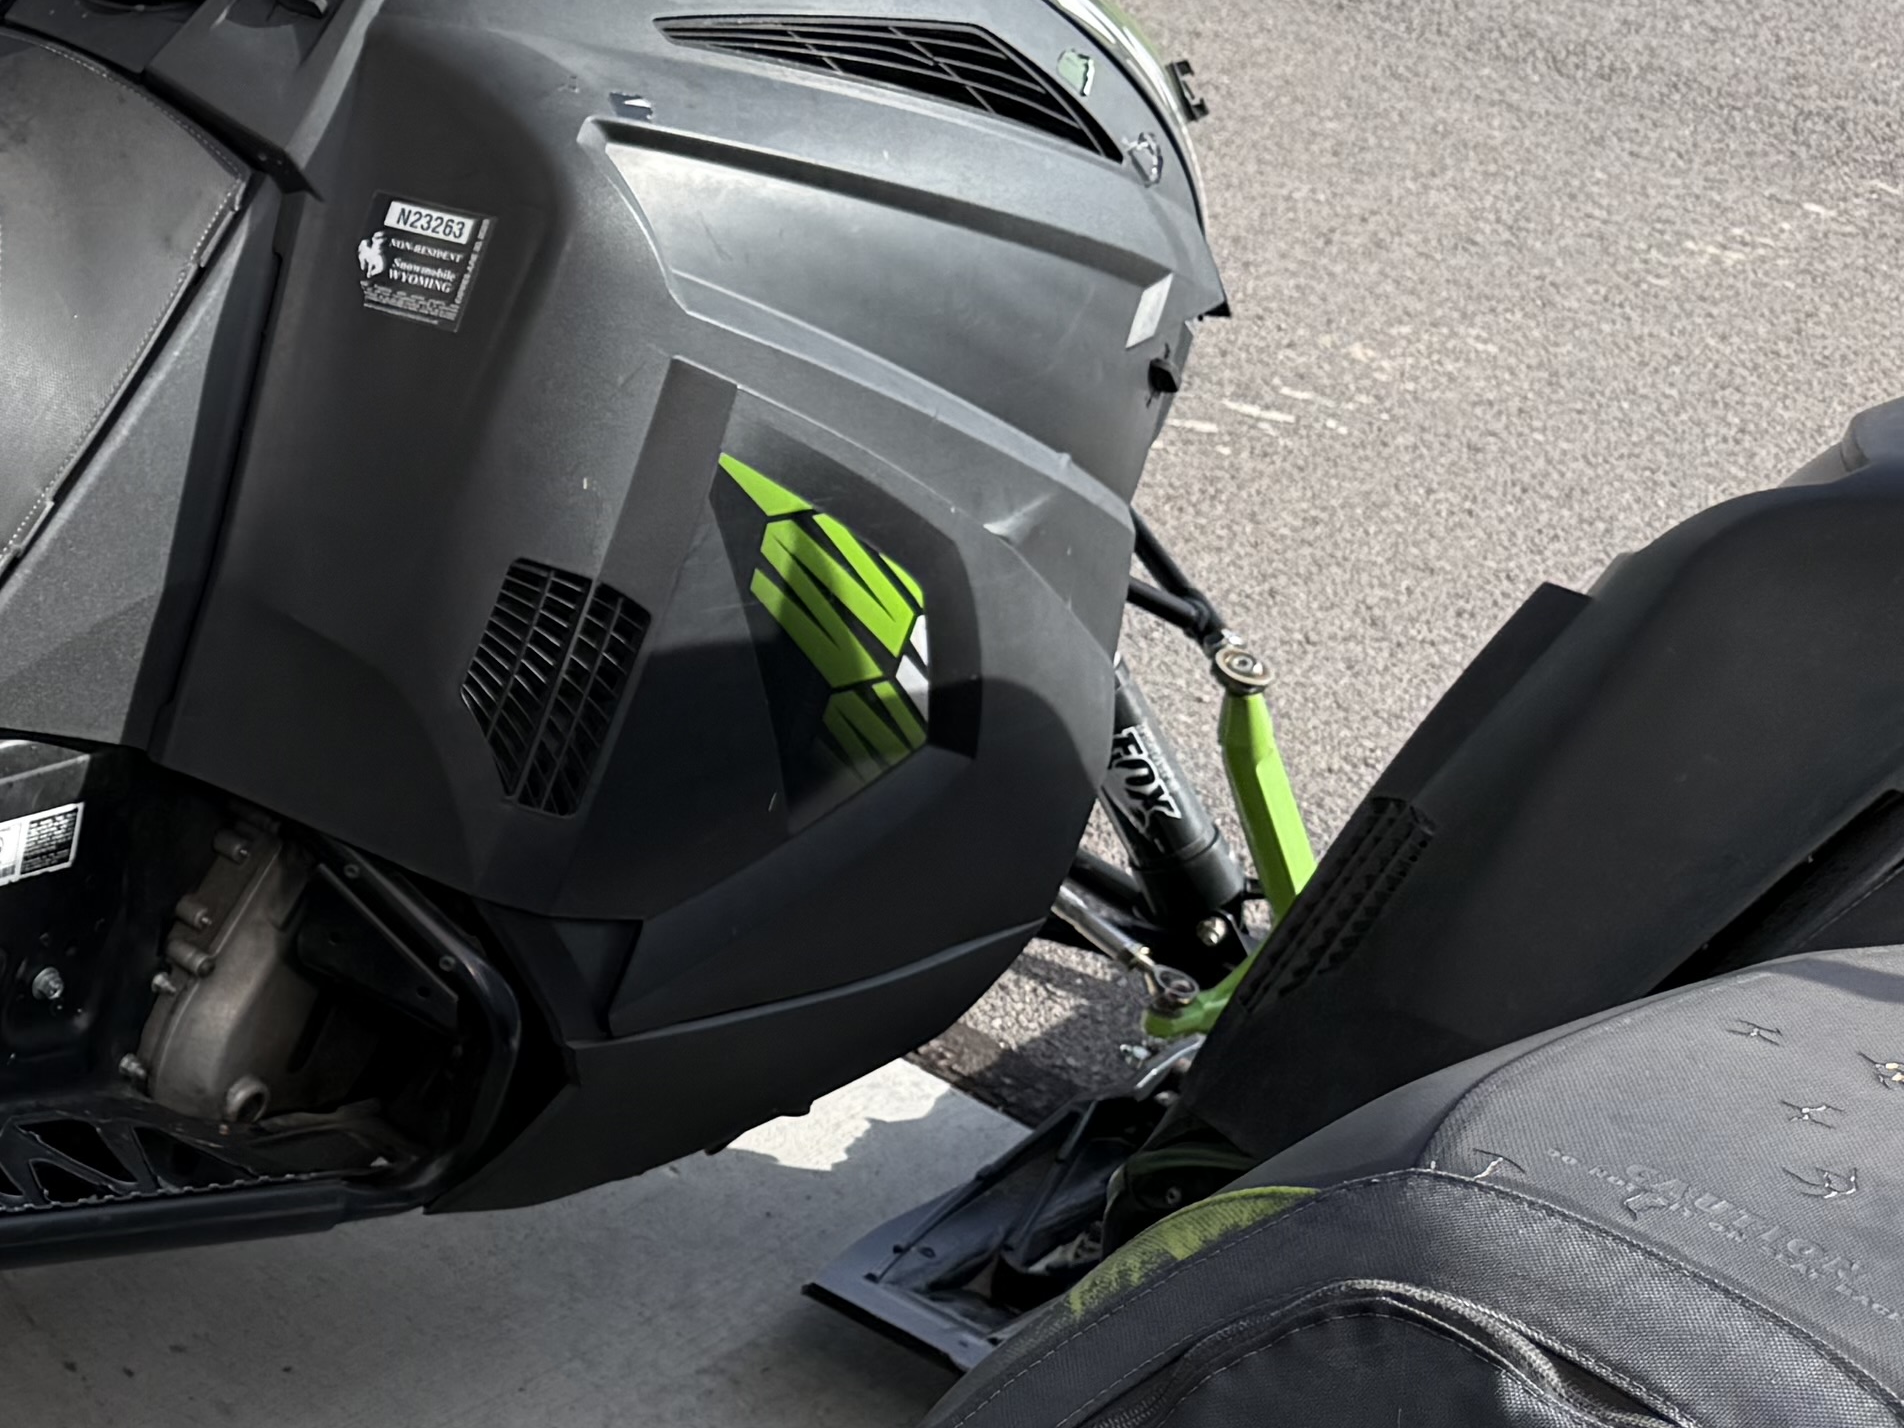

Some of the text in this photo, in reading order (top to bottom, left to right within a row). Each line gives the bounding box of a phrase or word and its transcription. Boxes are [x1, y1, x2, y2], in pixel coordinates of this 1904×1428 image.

[396, 207, 466, 240] N23263
[389, 237, 466, 264] NON-RESIDENT
[389, 269, 453, 294] WYOMING
[393, 257, 457, 283] Snowmobile
[1625, 1164, 1862, 1280] CAUTION
